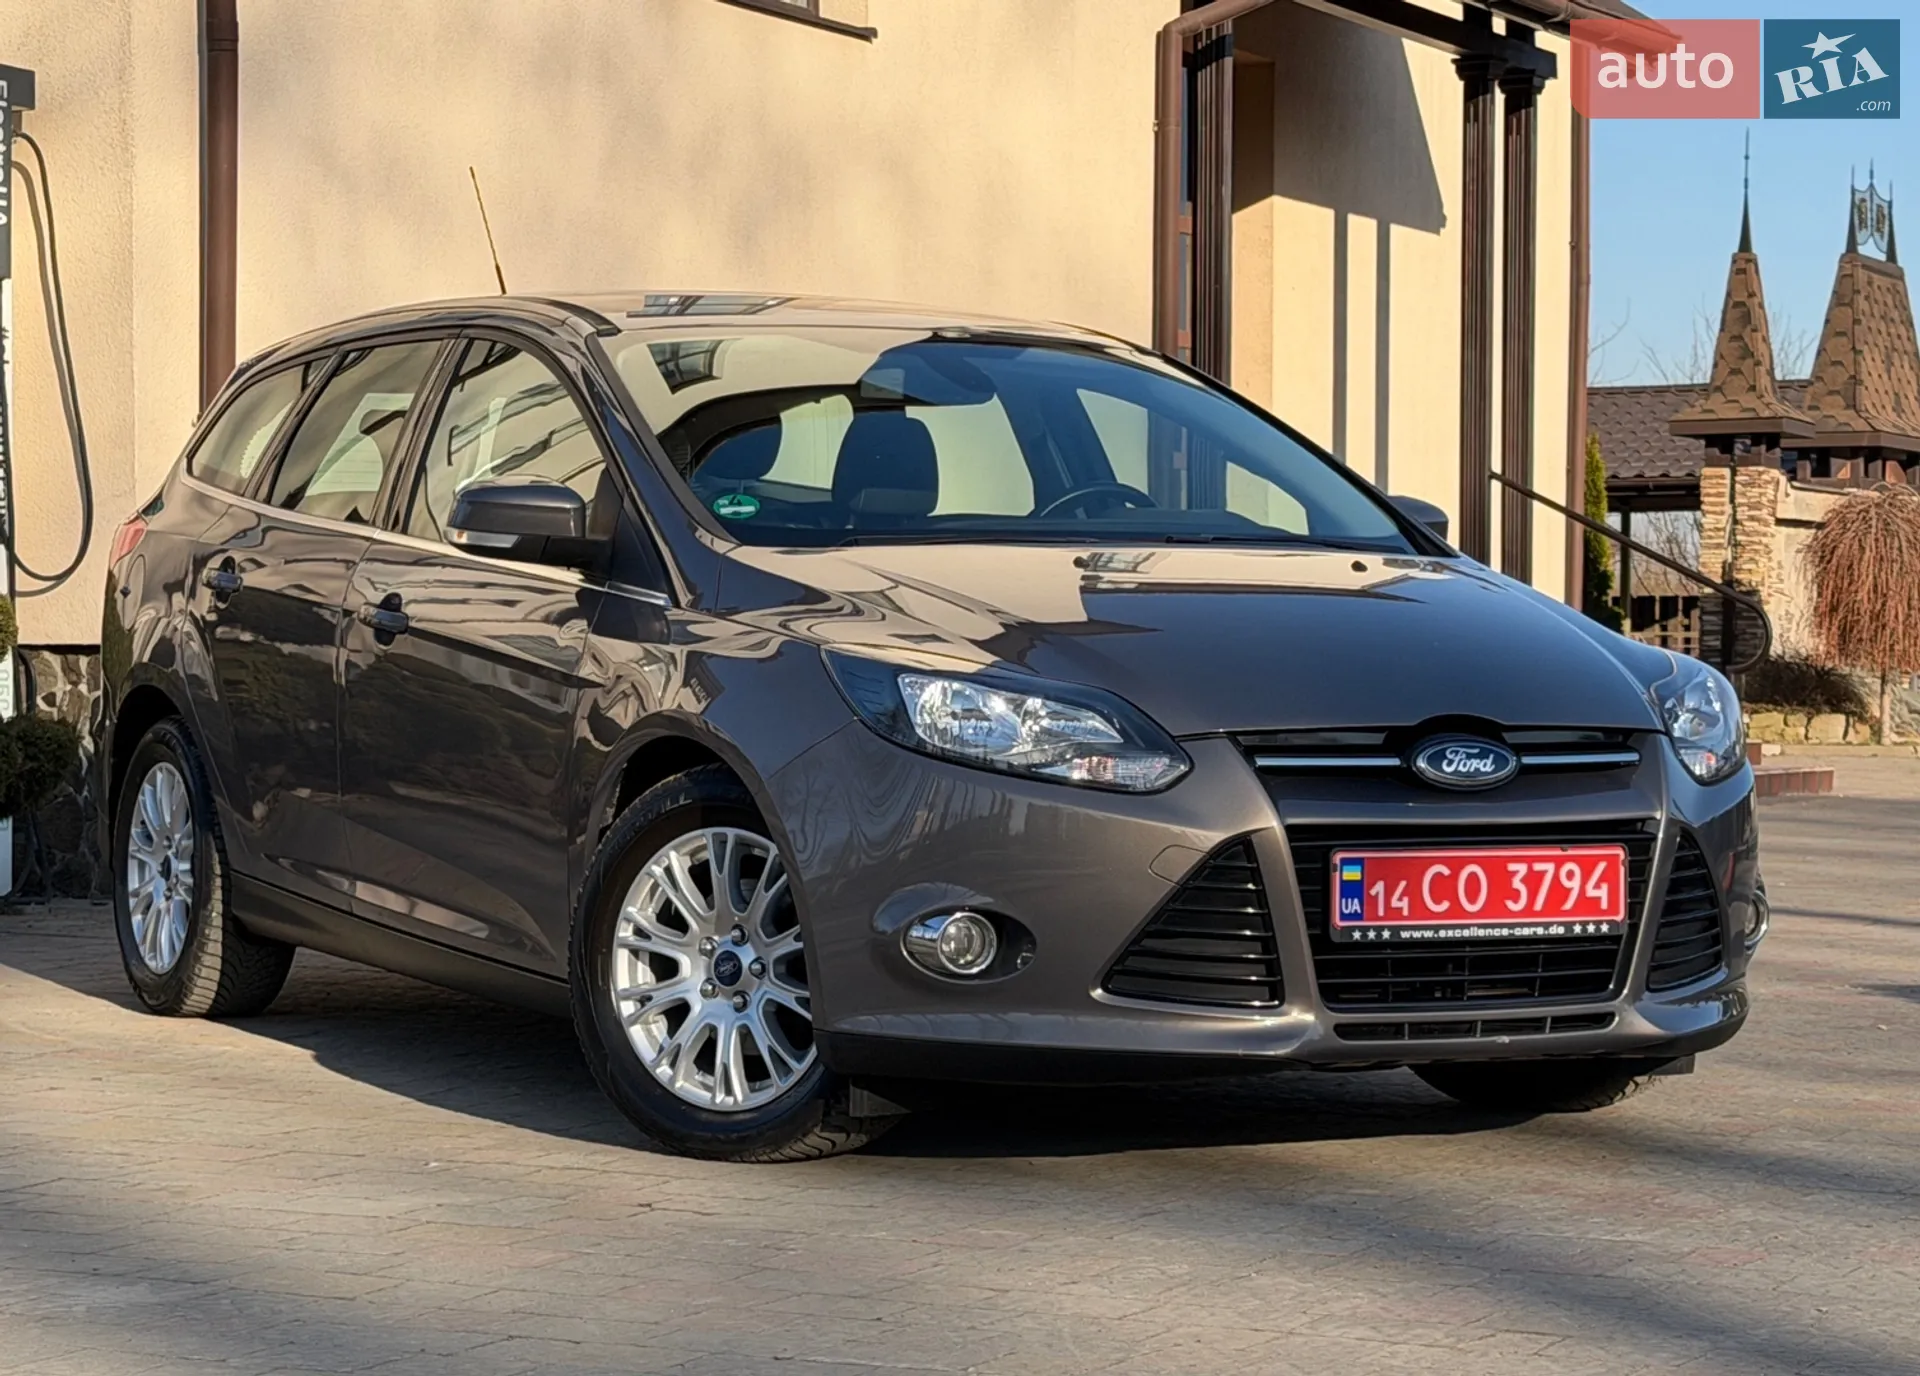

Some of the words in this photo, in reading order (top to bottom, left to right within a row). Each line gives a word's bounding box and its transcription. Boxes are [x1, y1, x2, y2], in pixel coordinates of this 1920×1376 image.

[1442, 747, 1495, 773] Ford
[1368, 880, 1409, 917] 14
[1422, 863, 1488, 913] CO
[1503, 861, 1608, 912] 3794
[1341, 898, 1361, 914] UA
[1400, 924, 1565, 938] www.excellence-cars.de
